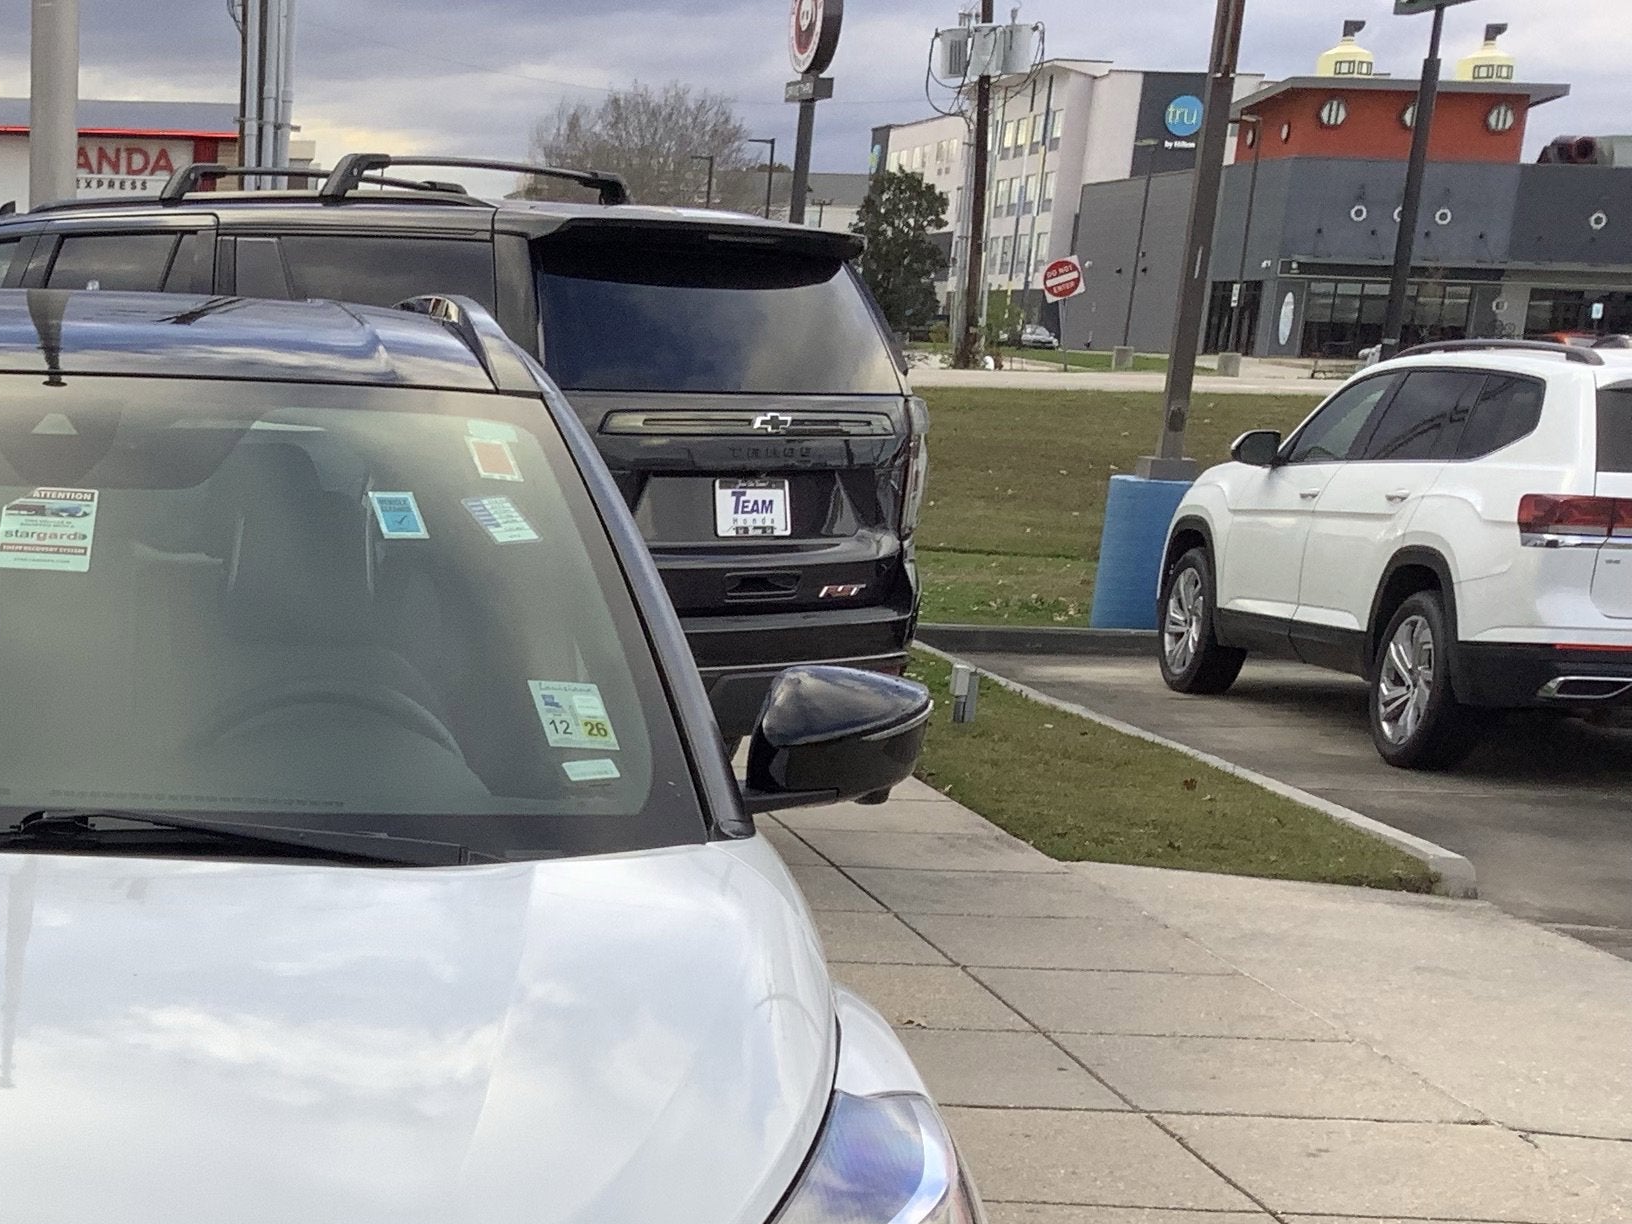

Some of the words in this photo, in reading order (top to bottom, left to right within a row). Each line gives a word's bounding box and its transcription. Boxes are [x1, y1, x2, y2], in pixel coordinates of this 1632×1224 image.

[1168, 104, 1198, 125] tru
[76, 146, 175, 176] ANDA
[33, 490, 92, 500] ATTENTION
[731, 491, 773, 514] TEAM
[549, 719, 573, 735] 12
[583, 721, 607, 737] 26
